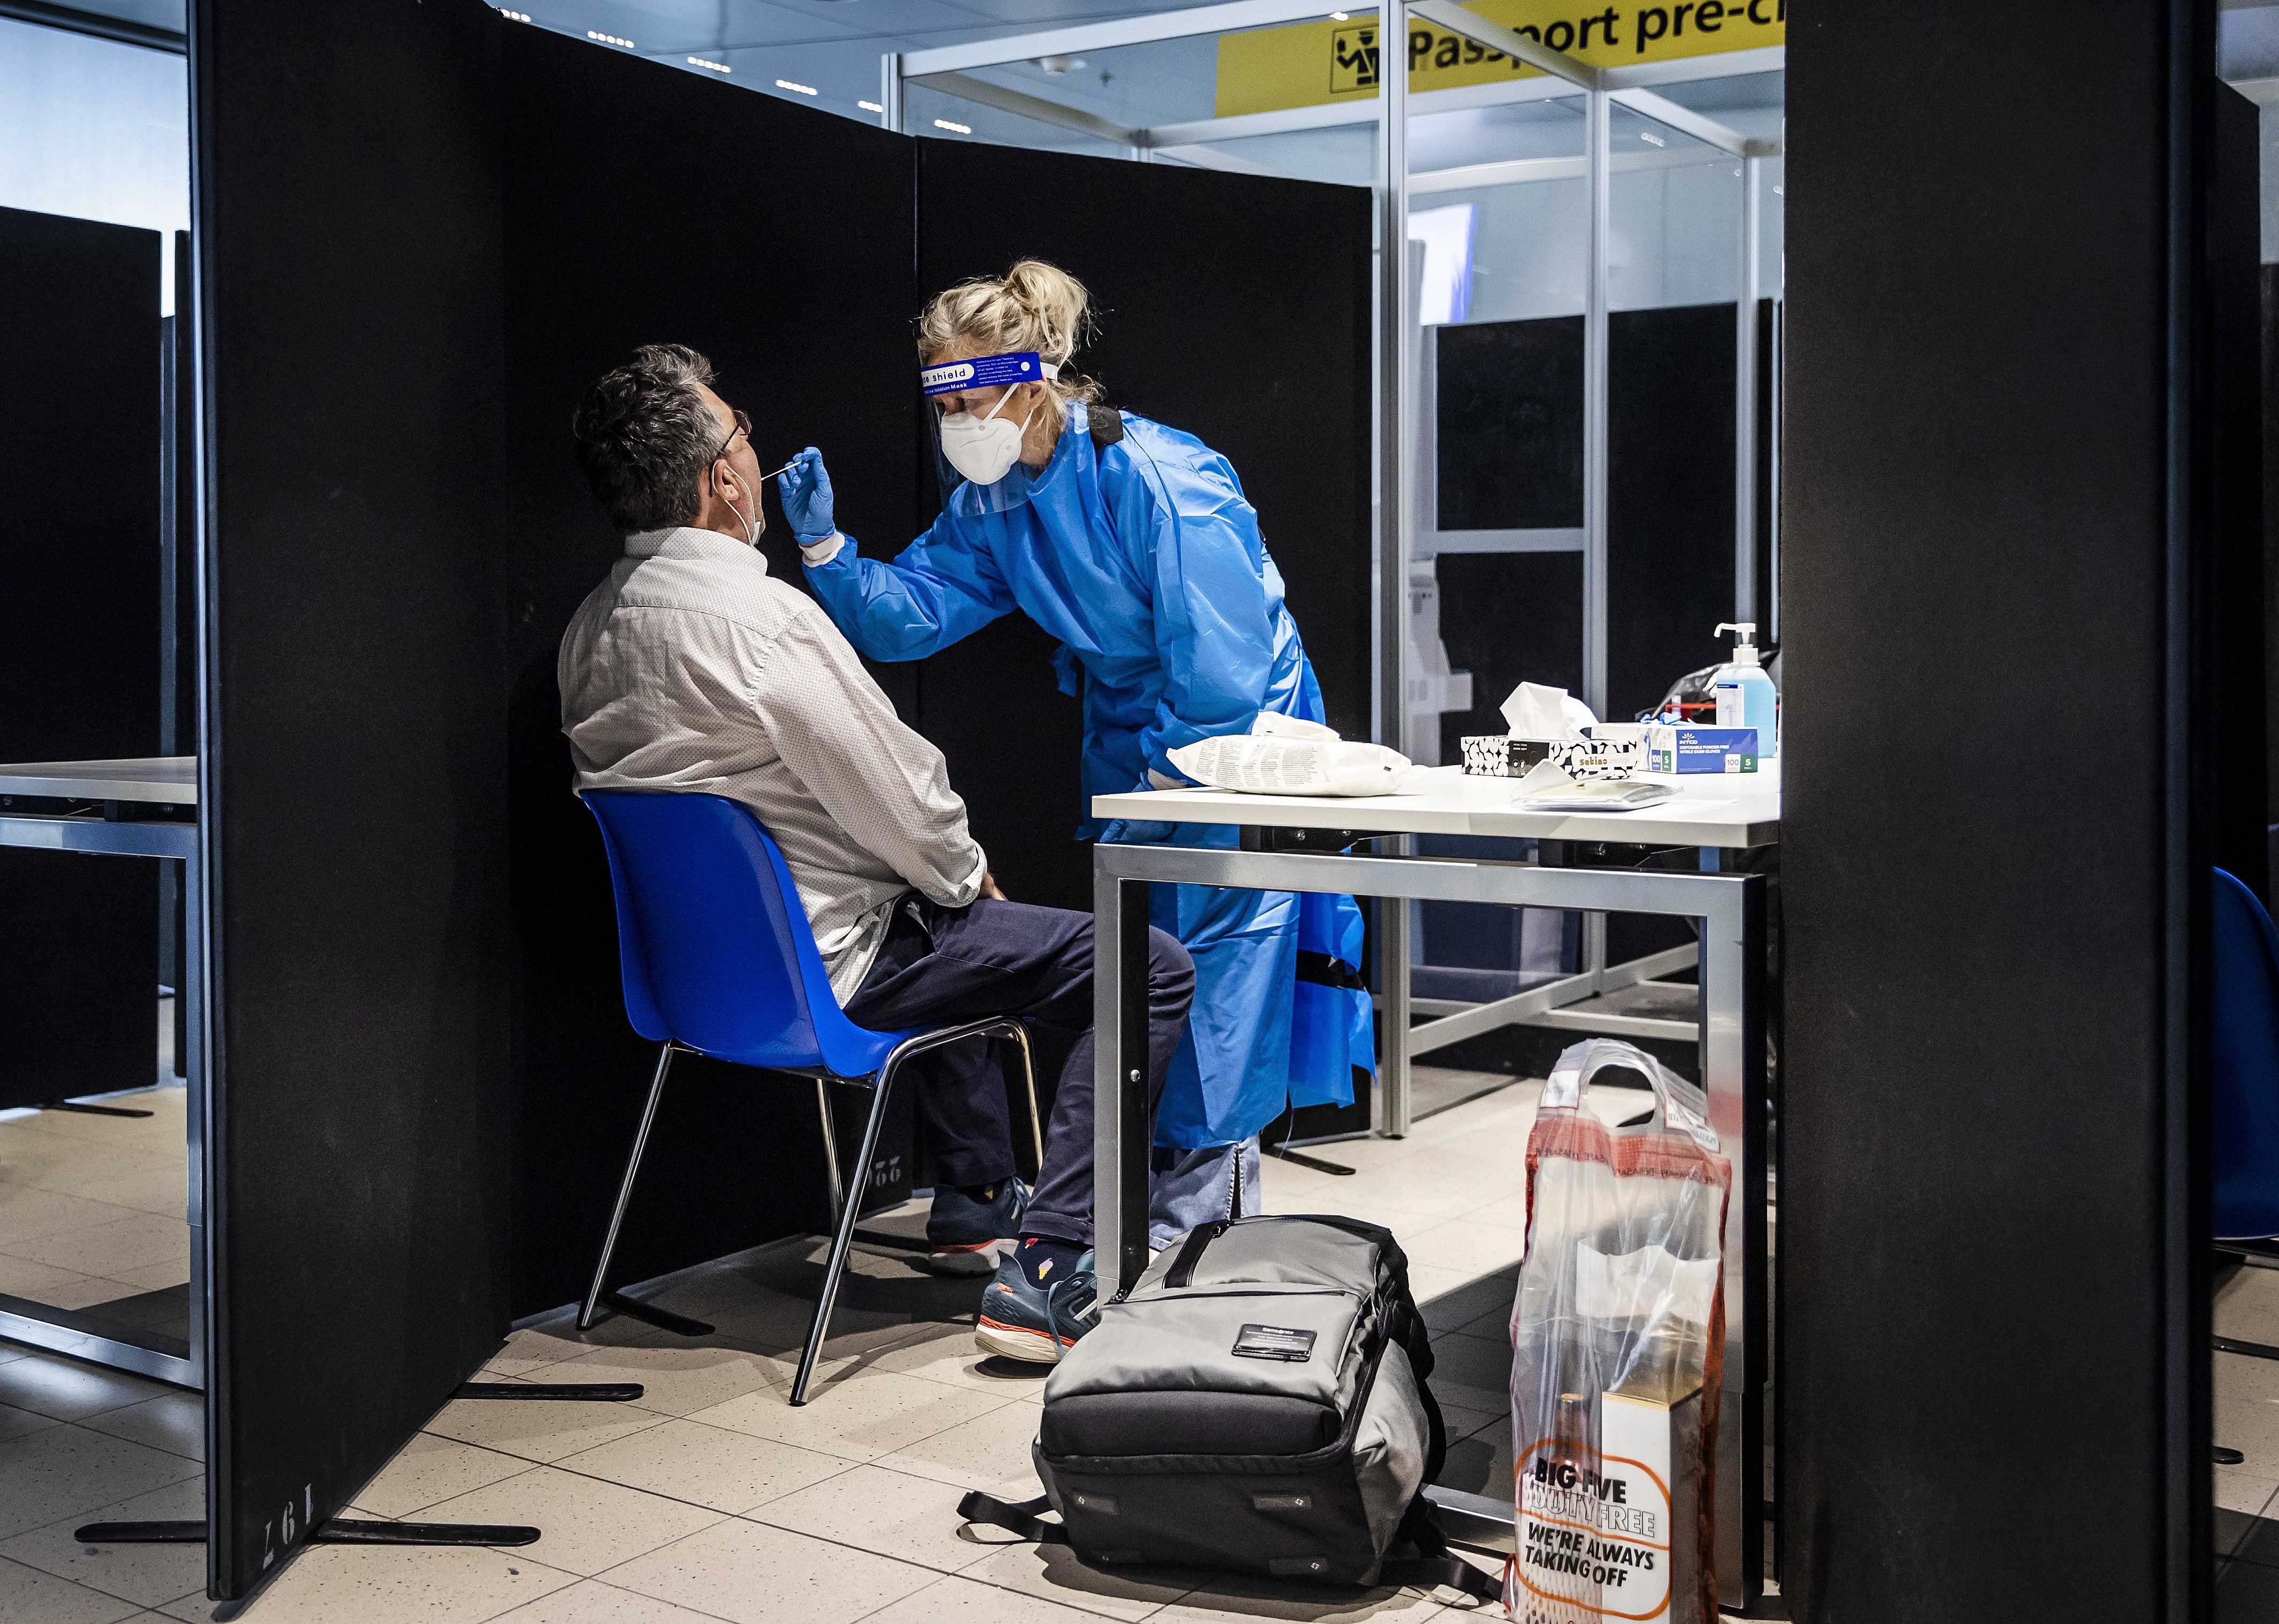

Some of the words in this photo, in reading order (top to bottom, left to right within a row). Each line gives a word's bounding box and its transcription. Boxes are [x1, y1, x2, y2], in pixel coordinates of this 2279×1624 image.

[933, 368, 966, 382] shield
[1579, 757, 1608, 766] satino
[1652, 755, 1661, 763] 100
[1664, 755, 1669, 763] S
[1745, 758, 1751, 766] S
[1535, 1457, 1577, 1489] BIG
[1582, 1469, 1626, 1504] FIVE
[1528, 1521, 1585, 1553] WE'RE
[1586, 1538, 1654, 1570] ALWAYS
[1525, 1545, 1591, 1578] TAKING
[1592, 1565, 1628, 1588] OFF
